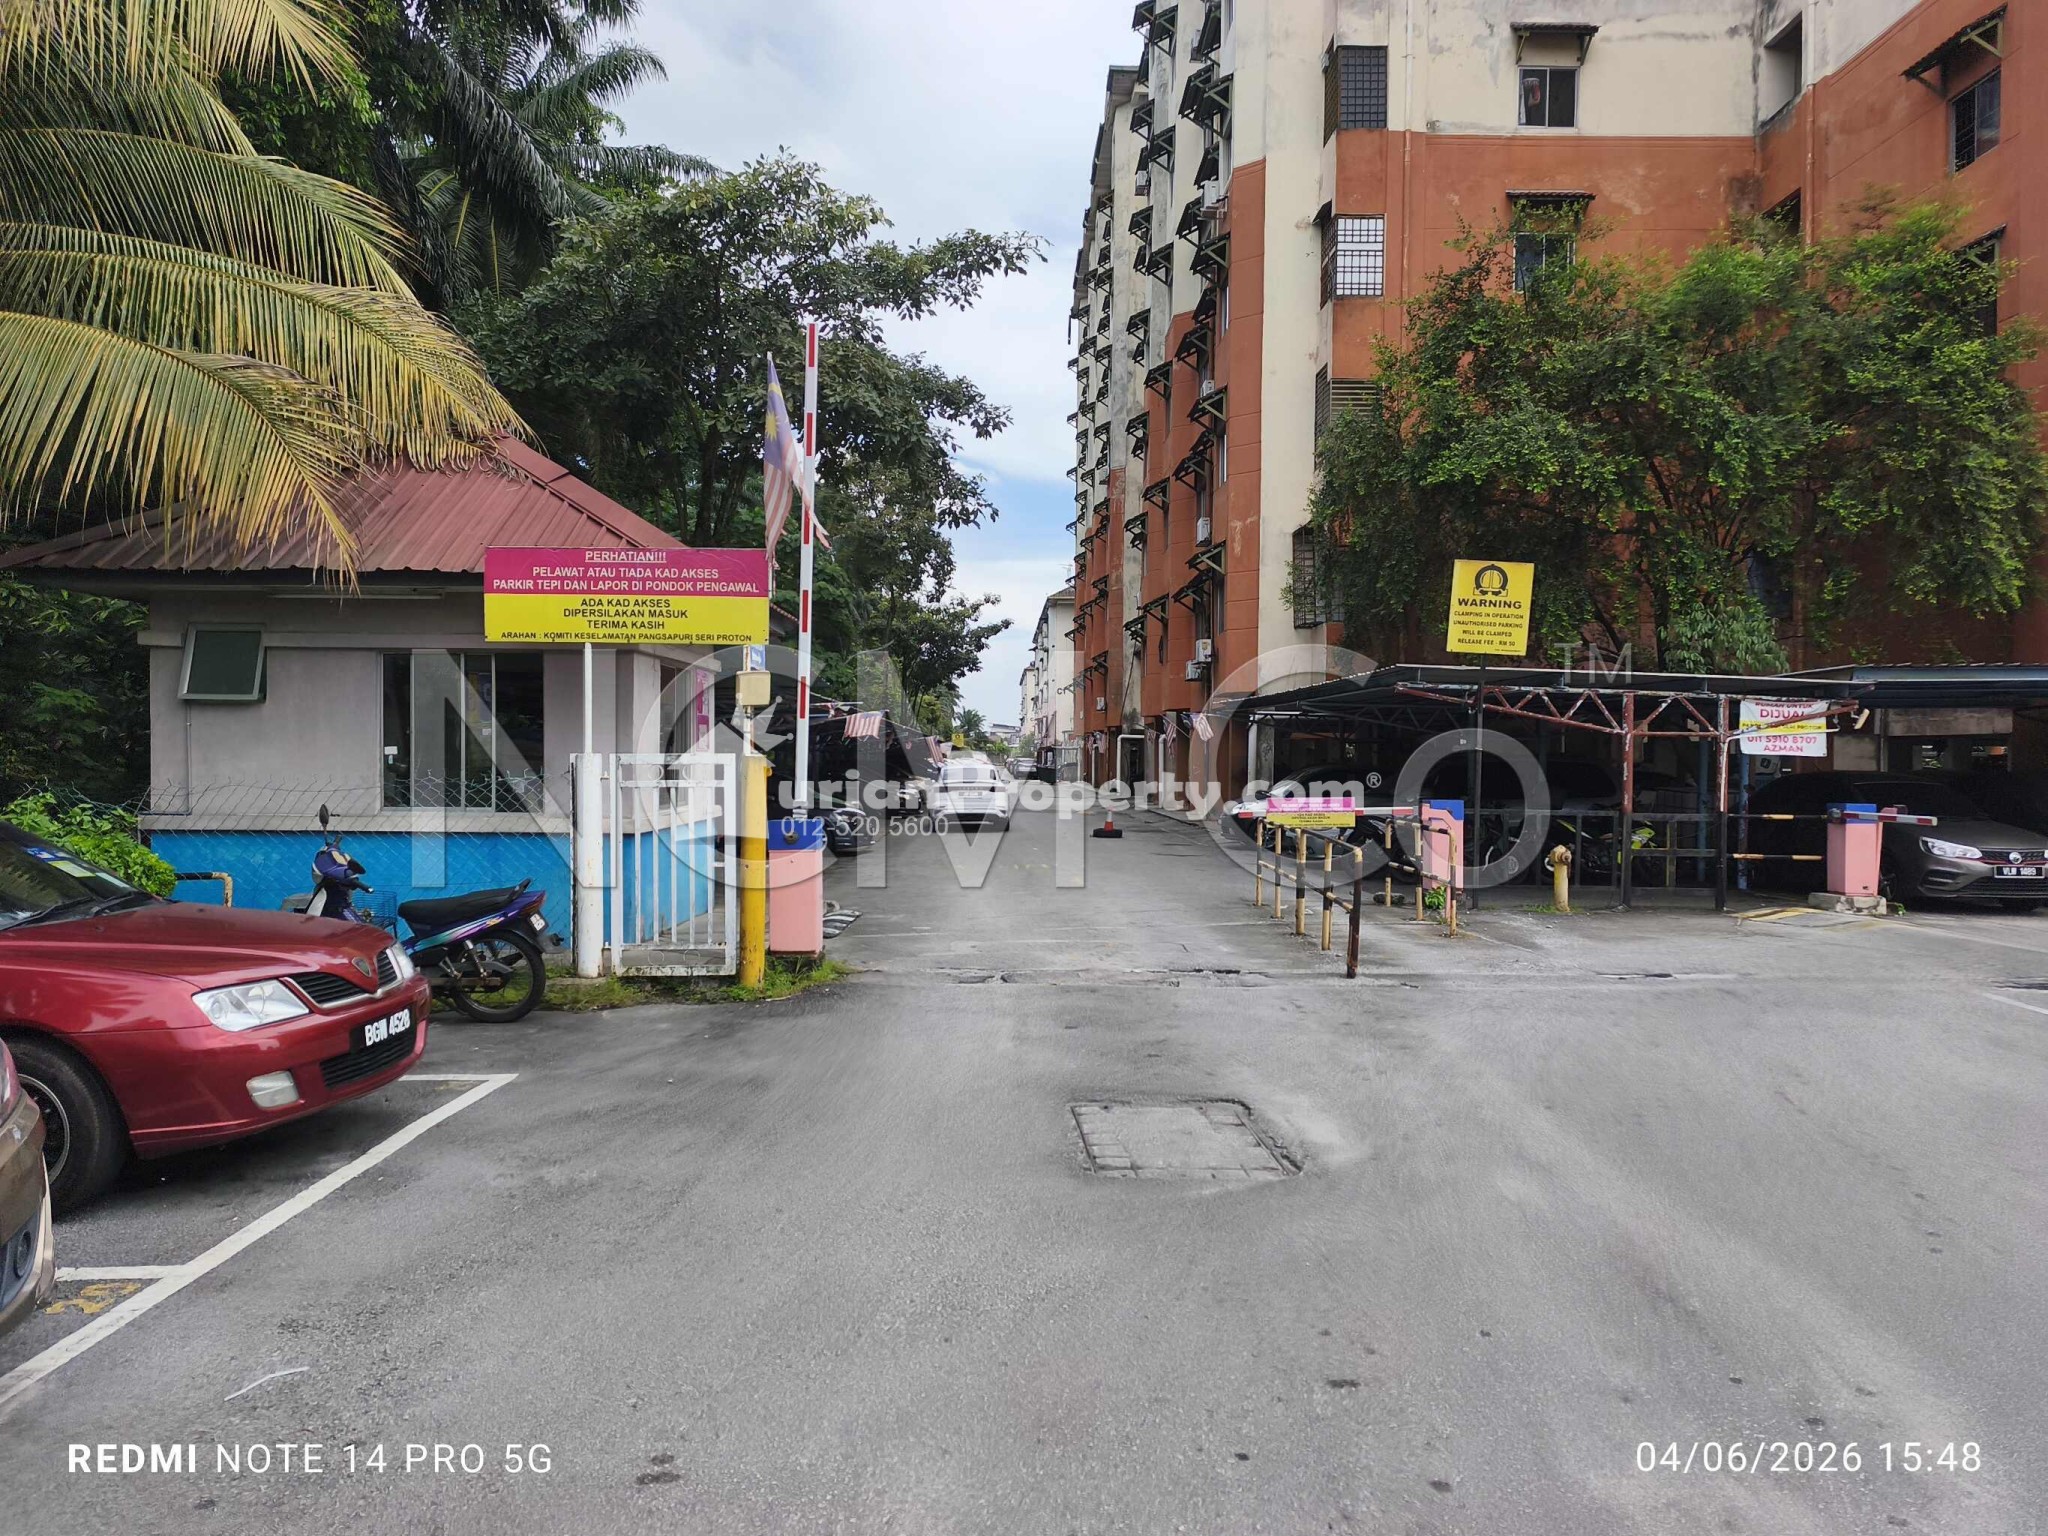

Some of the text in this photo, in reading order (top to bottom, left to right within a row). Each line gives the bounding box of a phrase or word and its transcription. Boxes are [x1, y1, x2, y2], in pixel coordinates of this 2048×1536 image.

[585, 551, 666, 562] PERHATIAN!!!
[533, 567, 719, 579] PELAWAT ATAU TIADA KAD AKSES
[493, 580, 759, 593] PARKIR TEPI DAN LAPOR DI PONDOK PENGAWAL
[580, 599, 670, 608] ADA KAD AKSES
[1458, 598, 1522, 609] WARNING
[563, 608, 688, 619] DIPERSILAKAN MASUK
[587, 620, 665, 629] TERIMA KASIH
[575, 632, 636, 640] KESELAMATAN
[639, 633, 693, 641] PANGSAPURI
[716, 634, 752, 642] PROTON
